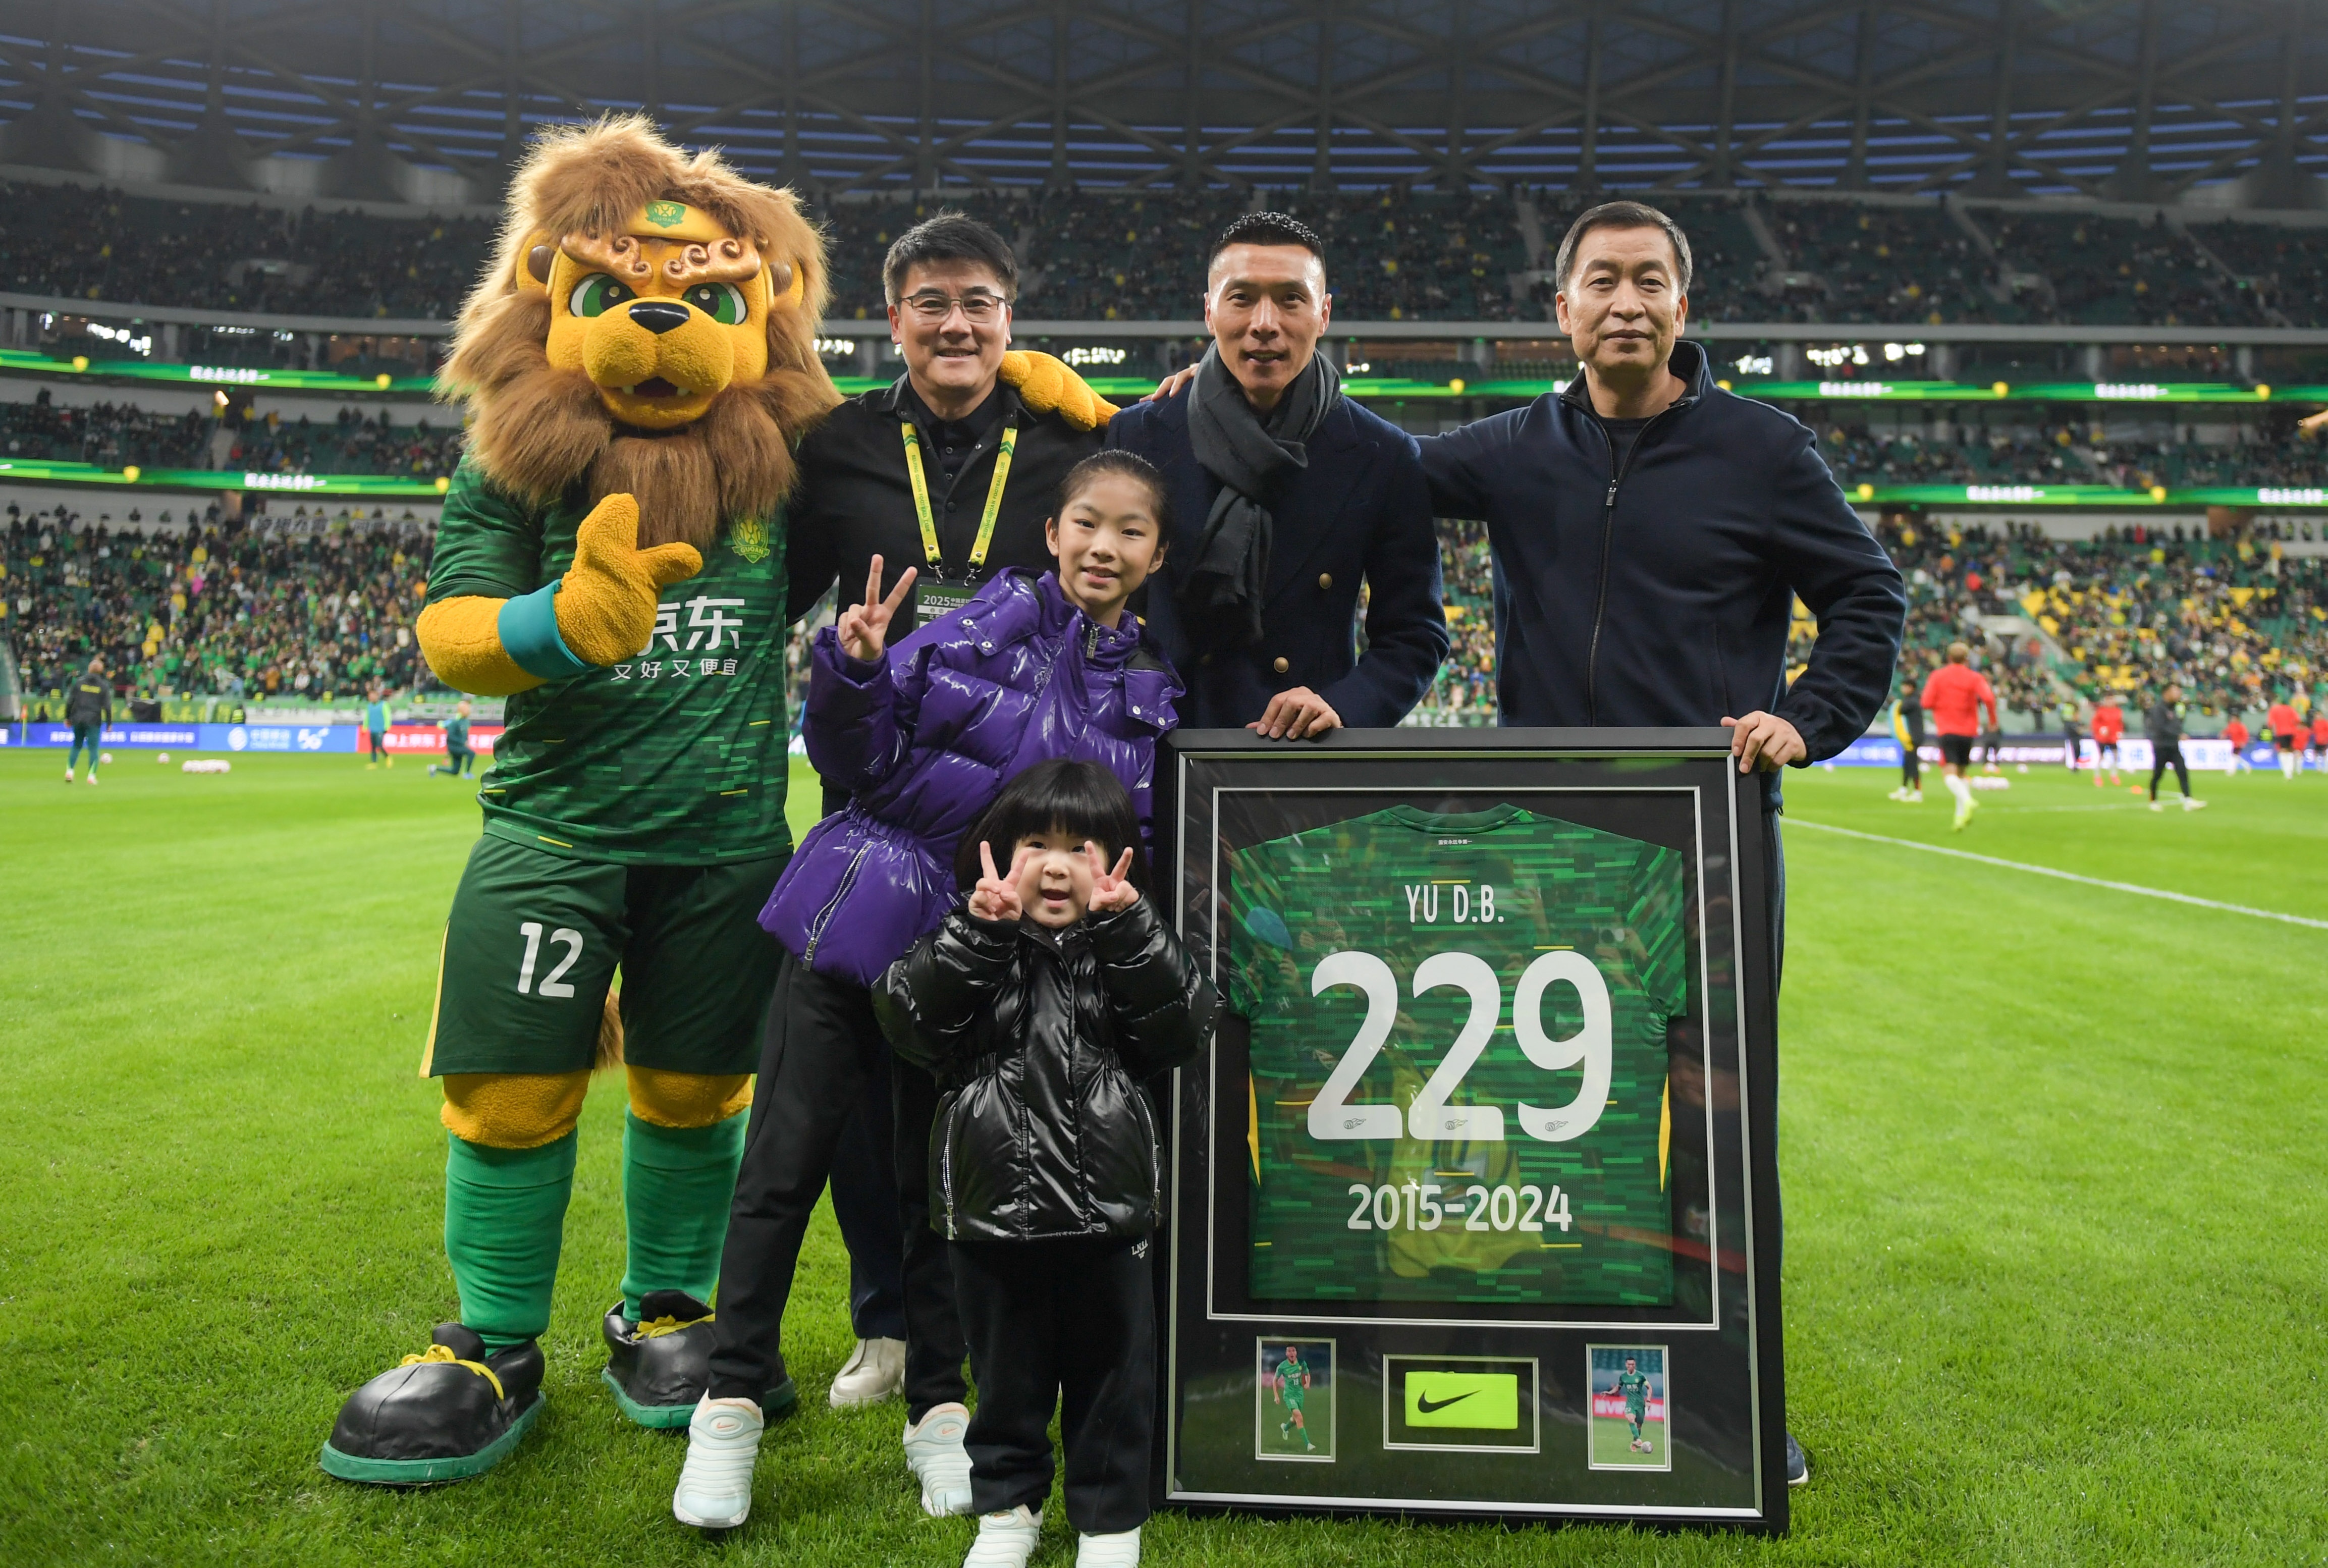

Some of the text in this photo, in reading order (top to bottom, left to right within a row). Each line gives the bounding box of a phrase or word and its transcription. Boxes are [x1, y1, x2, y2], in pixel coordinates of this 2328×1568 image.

[919, 493, 927, 518] FOOTBALL
[982, 519, 991, 538] BEIJING
[993, 474, 1002, 500] FOOTBALL
[740, 546, 764, 555] GUOAN
[924, 595, 950, 606] 2025
[611, 658, 738, 681] 又好又便宜
[1404, 884, 1504, 923] YU D.B.
[517, 922, 583, 998] 12
[1307, 950, 1612, 1142] 229
[1347, 1184, 1573, 1232] 2015-2024
